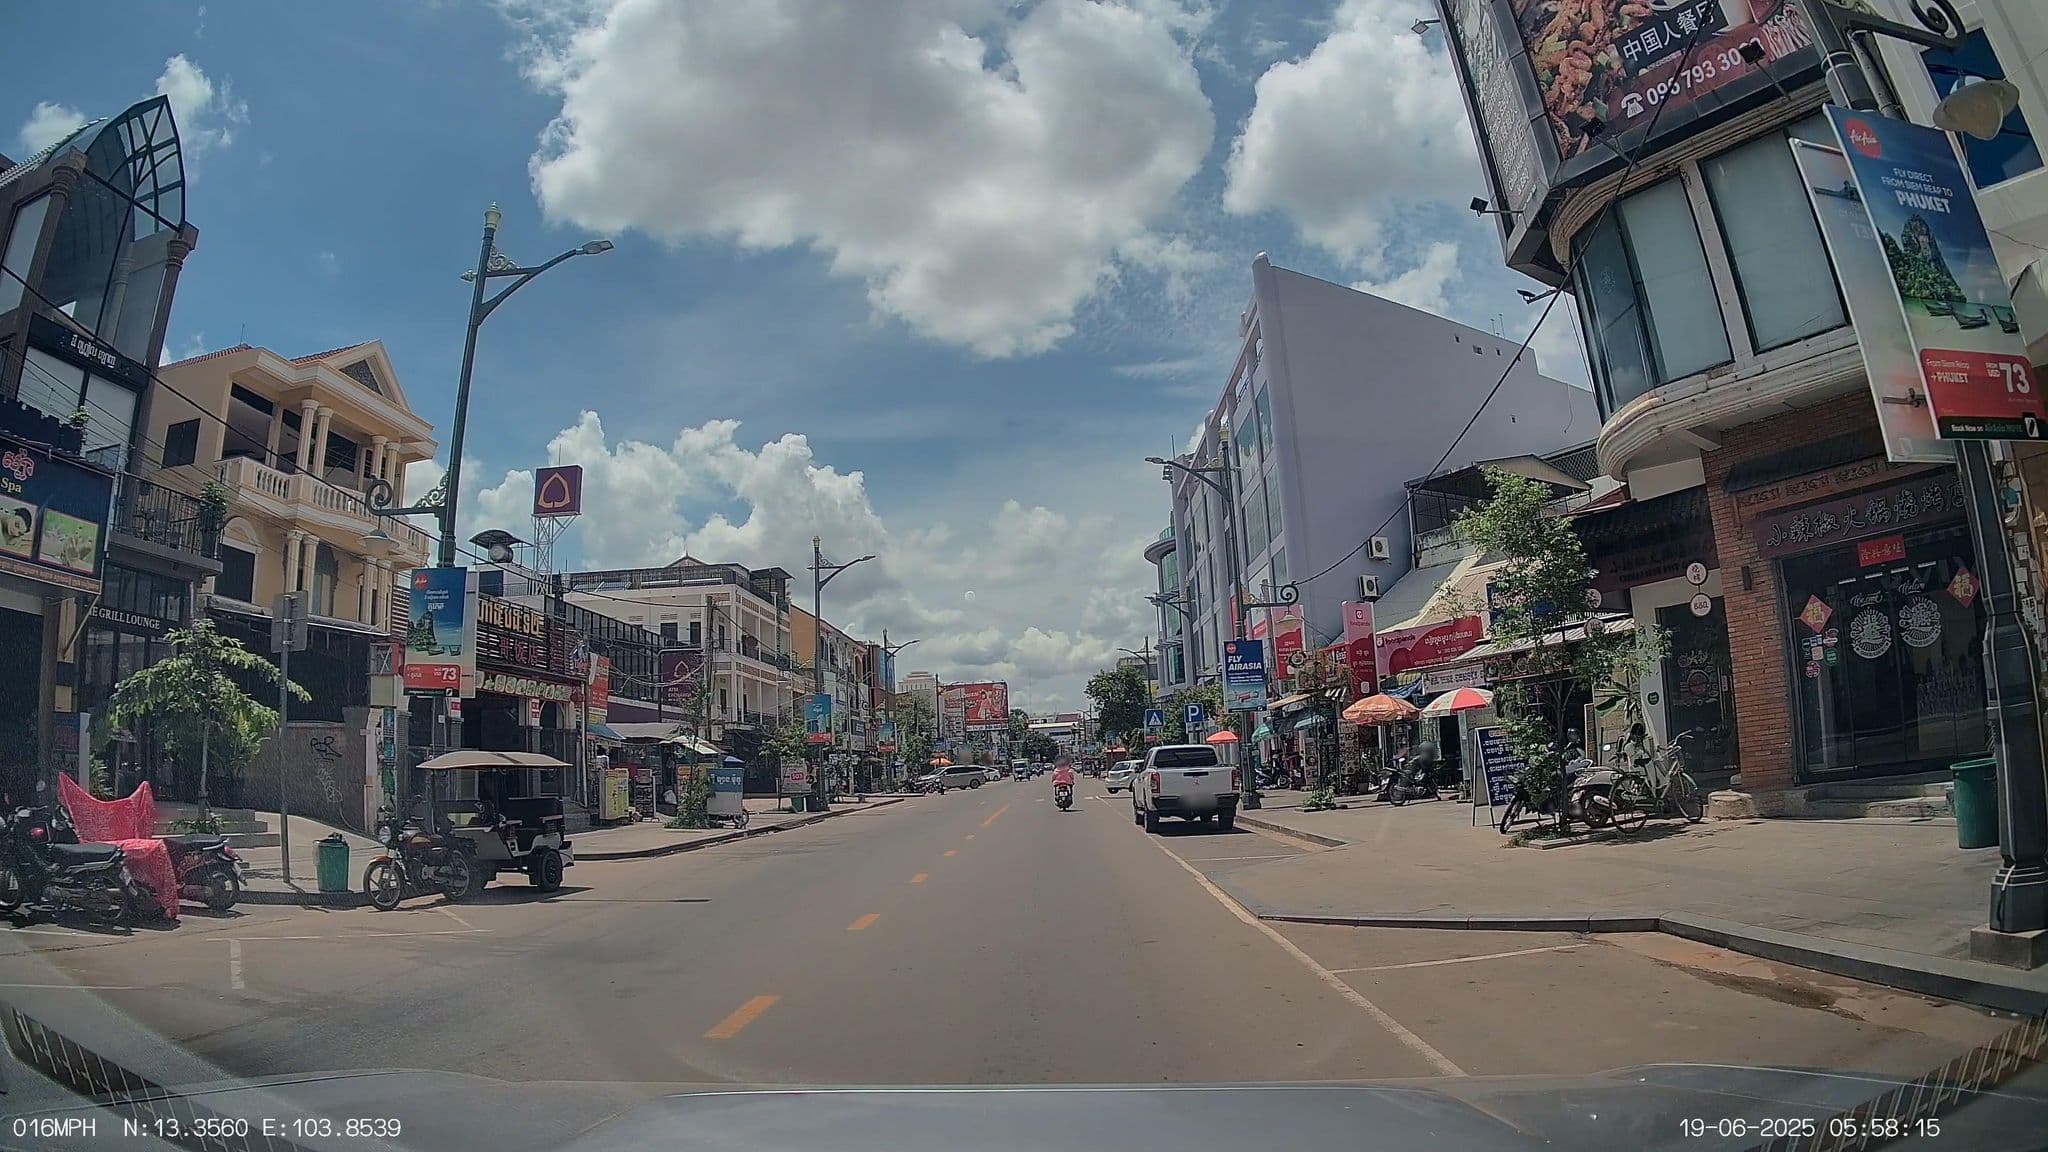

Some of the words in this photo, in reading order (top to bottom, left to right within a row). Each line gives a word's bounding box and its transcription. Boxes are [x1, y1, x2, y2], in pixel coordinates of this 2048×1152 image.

[1681, 60, 1716, 89] 793
[1717, 37, 1765, 72] 30
[1893, 167, 1907, 178] FLY
[1907, 169, 1934, 184] DIRECT
[1881, 176, 1905, 188] FROM
[1904, 179, 1924, 192] SIEM
[1942, 187, 1954, 198] TO
[1895, 190, 1951, 214] PHUKET
[1936, 371, 1969, 384] PHUKET
[2000, 362, 2030, 394] 73
[0, 476, 22, 494] Spa
[99, 607, 125, 624] GRILL
[126, 612, 161, 630] LOUNGE
[1228, 655, 1242, 663] FLY
[1228, 662, 1262, 672] AIRASIA
[442, 667, 457, 681] 73
[1187, 705, 1199, 722] P
